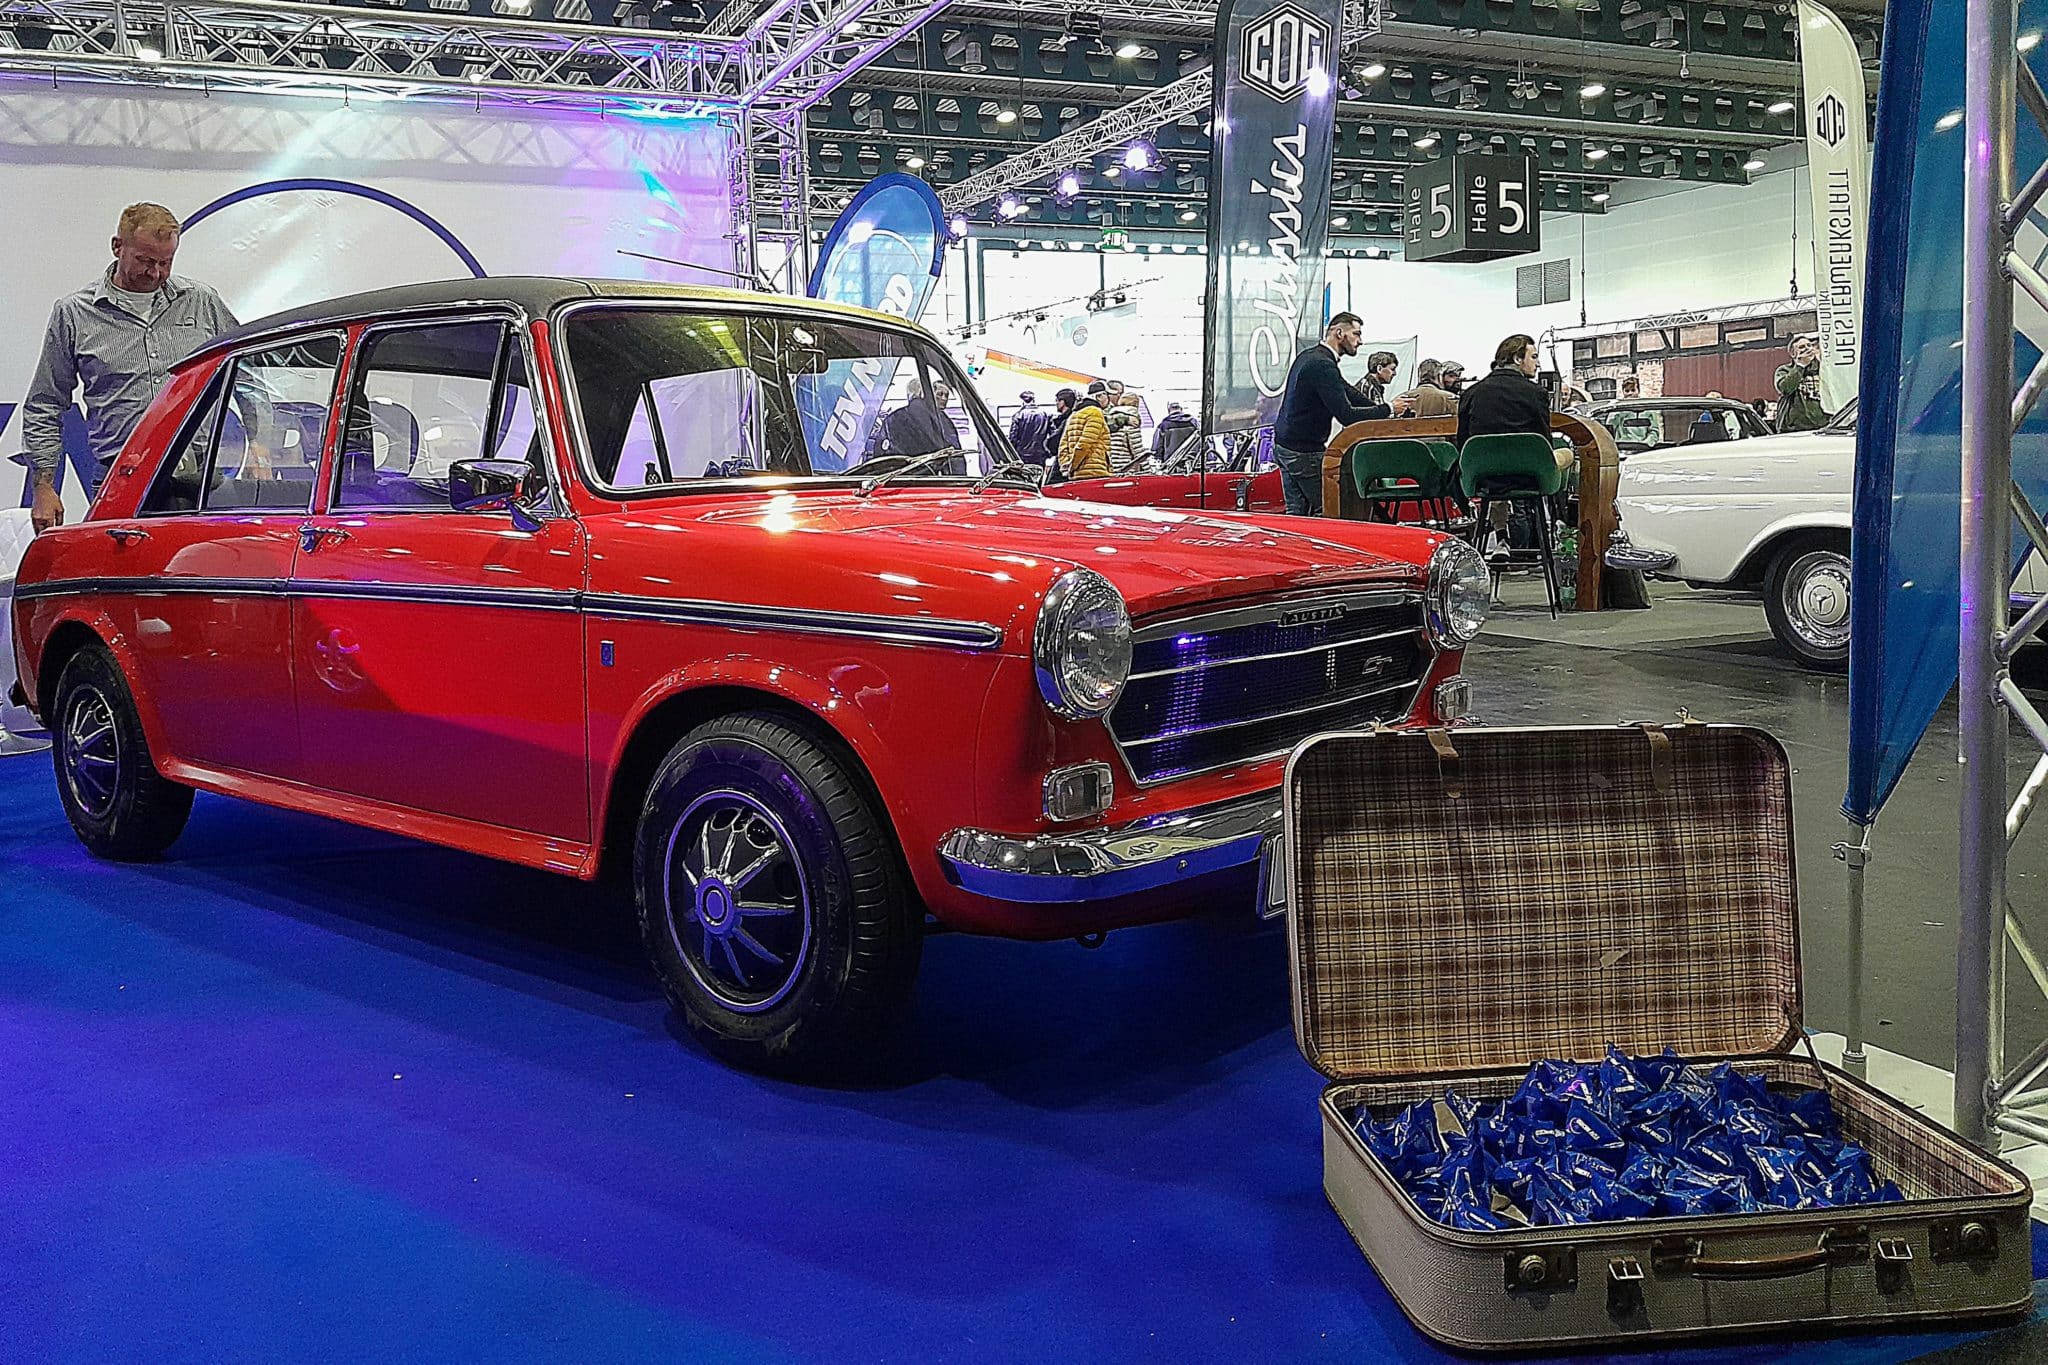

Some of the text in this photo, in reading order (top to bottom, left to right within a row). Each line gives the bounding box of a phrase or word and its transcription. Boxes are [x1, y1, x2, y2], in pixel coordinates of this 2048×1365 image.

[1250, 13, 1321, 91] COG
[1408, 183, 1452, 244] Halle 5
[1470, 175, 1525, 234] Halle 5
[1290, 606, 1344, 622] AUSTIN
